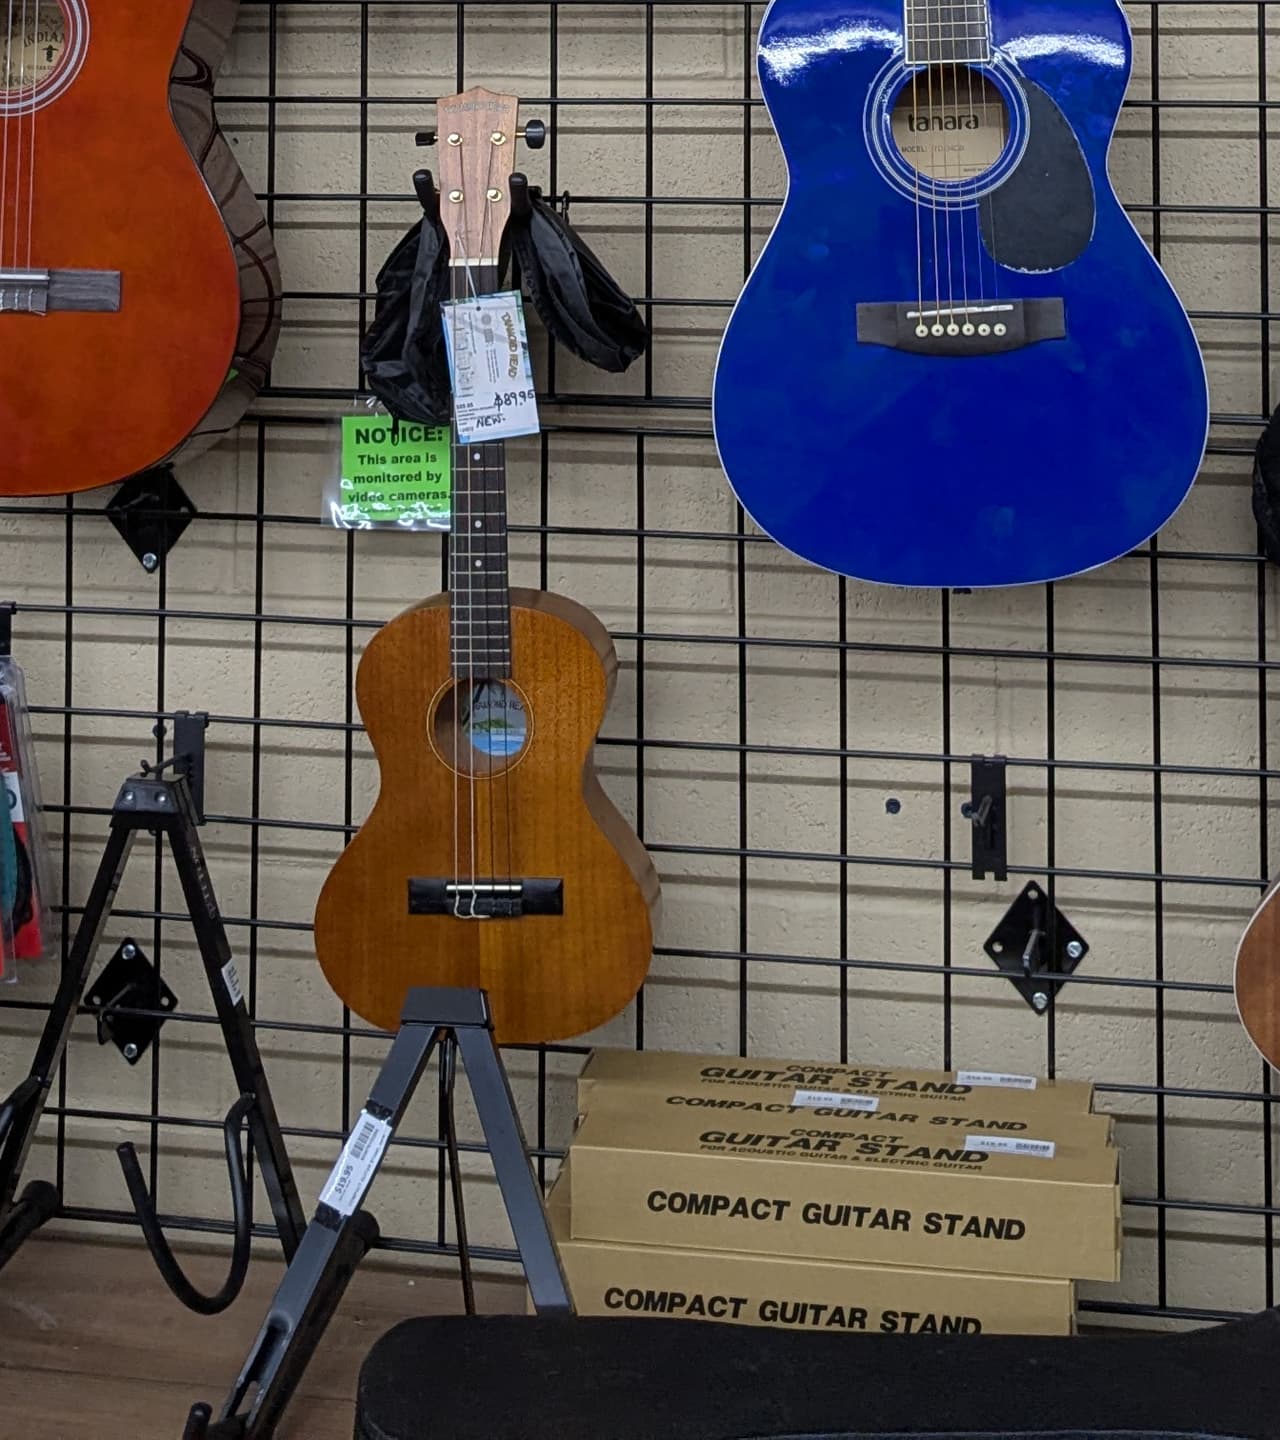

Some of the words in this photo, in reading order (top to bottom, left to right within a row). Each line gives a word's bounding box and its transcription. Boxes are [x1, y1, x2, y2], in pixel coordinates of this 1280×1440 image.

[908, 114, 979, 133] tanara
[357, 453, 387, 465] This
[391, 454, 421, 464] area
[425, 452, 437, 462] is
[353, 471, 422, 484] monitored
[426, 471, 442, 484] by
[348, 491, 385, 503] video
[700, 1066, 834, 1086] GUITAR
[848, 1075, 973, 1096] STAND
[785, 1064, 892, 1078] COMPACT
[726, 1078, 791, 1090] ACOUSTIC
[855, 1088, 917, 1099] ELECTRIC
[920, 1094, 967, 1102] GUITAR
[666, 1096, 804, 1114] COMPACT
[814, 1107, 920, 1123] GUITAR
[929, 1116, 1028, 1131] STAND
[699, 1131, 841, 1152] GUITAR
[856, 1142, 989, 1163] STAND
[790, 1129, 904, 1144] COMPACT
[700, 1144, 722, 1152] FOR
[726, 1145, 796, 1157] ACOUSTIC
[799, 1151, 848, 1161] GUITAR
[865, 1157, 928, 1168] ELECTRIC
[933, 1162, 982, 1171] GUITAR
[334, 1164, 354, 1194] $19.95
[647, 1189, 790, 1222] COMPACT
[801, 1203, 911, 1232] GUITAR
[923, 1212, 1026, 1241] STAND
[604, 1287, 747, 1320] COMPACT
[758, 1300, 867, 1329] GUITAR
[879, 1311, 982, 1334] STAND
